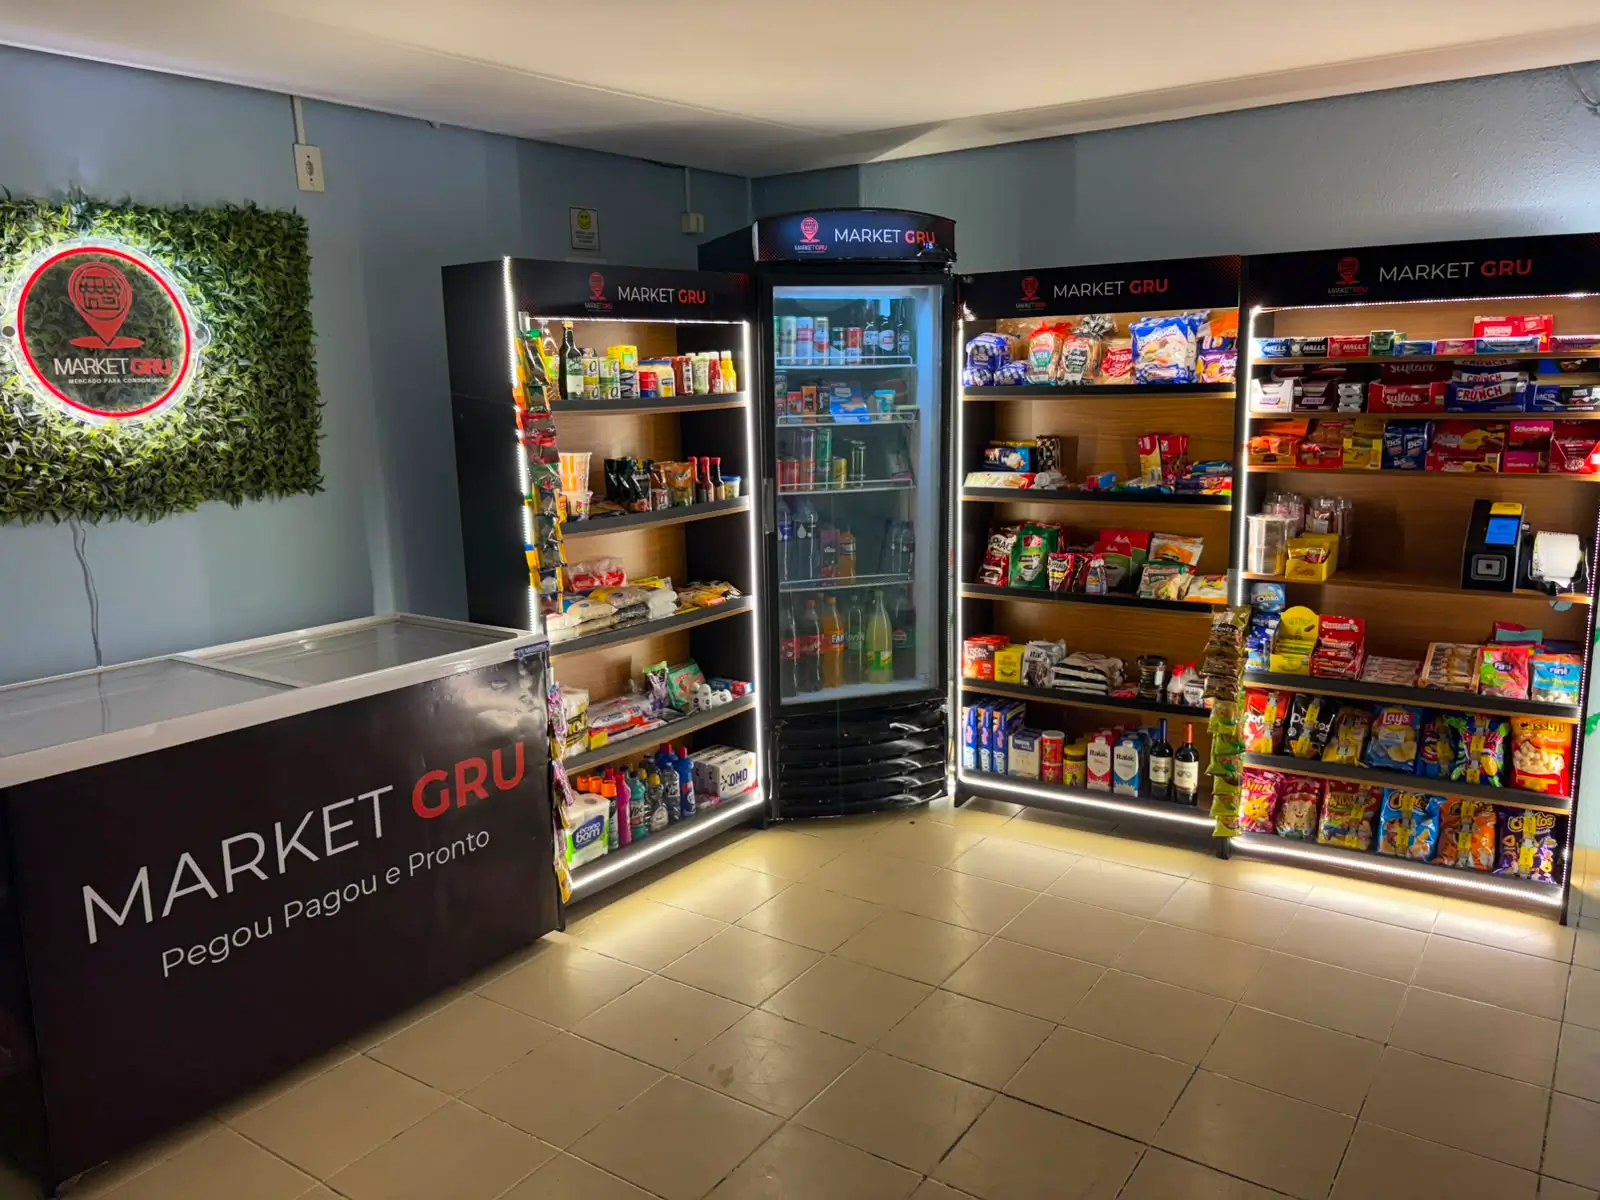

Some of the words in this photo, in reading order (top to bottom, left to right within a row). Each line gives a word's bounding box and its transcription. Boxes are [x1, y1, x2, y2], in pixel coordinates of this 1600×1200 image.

[833, 228, 901, 244] MARKET
[904, 230, 936, 244] GRU
[1379, 261, 1475, 282] MARKET
[1480, 259, 1533, 277] GRU
[617, 286, 675, 303] MARKET
[678, 289, 706, 304] GRU
[1052, 280, 1125, 299] MARKET
[1129, 278, 1169, 295] GRU
[53, 357, 128, 375] MARKET
[130, 356, 172, 375] GRU
[1457, 387, 1503, 401] CRUNCH
[1382, 711, 1411, 726] Lay's
[729, 767, 748, 787] OMO
[82, 785, 394, 944] MARKET
[412, 742, 525, 820] GRU
[575, 828, 601, 843] bom
[162, 915, 273, 978] Pegou
[284, 874, 378, 928] Pagou
[384, 866, 401, 886] e
[408, 829, 490, 878] Pronto
